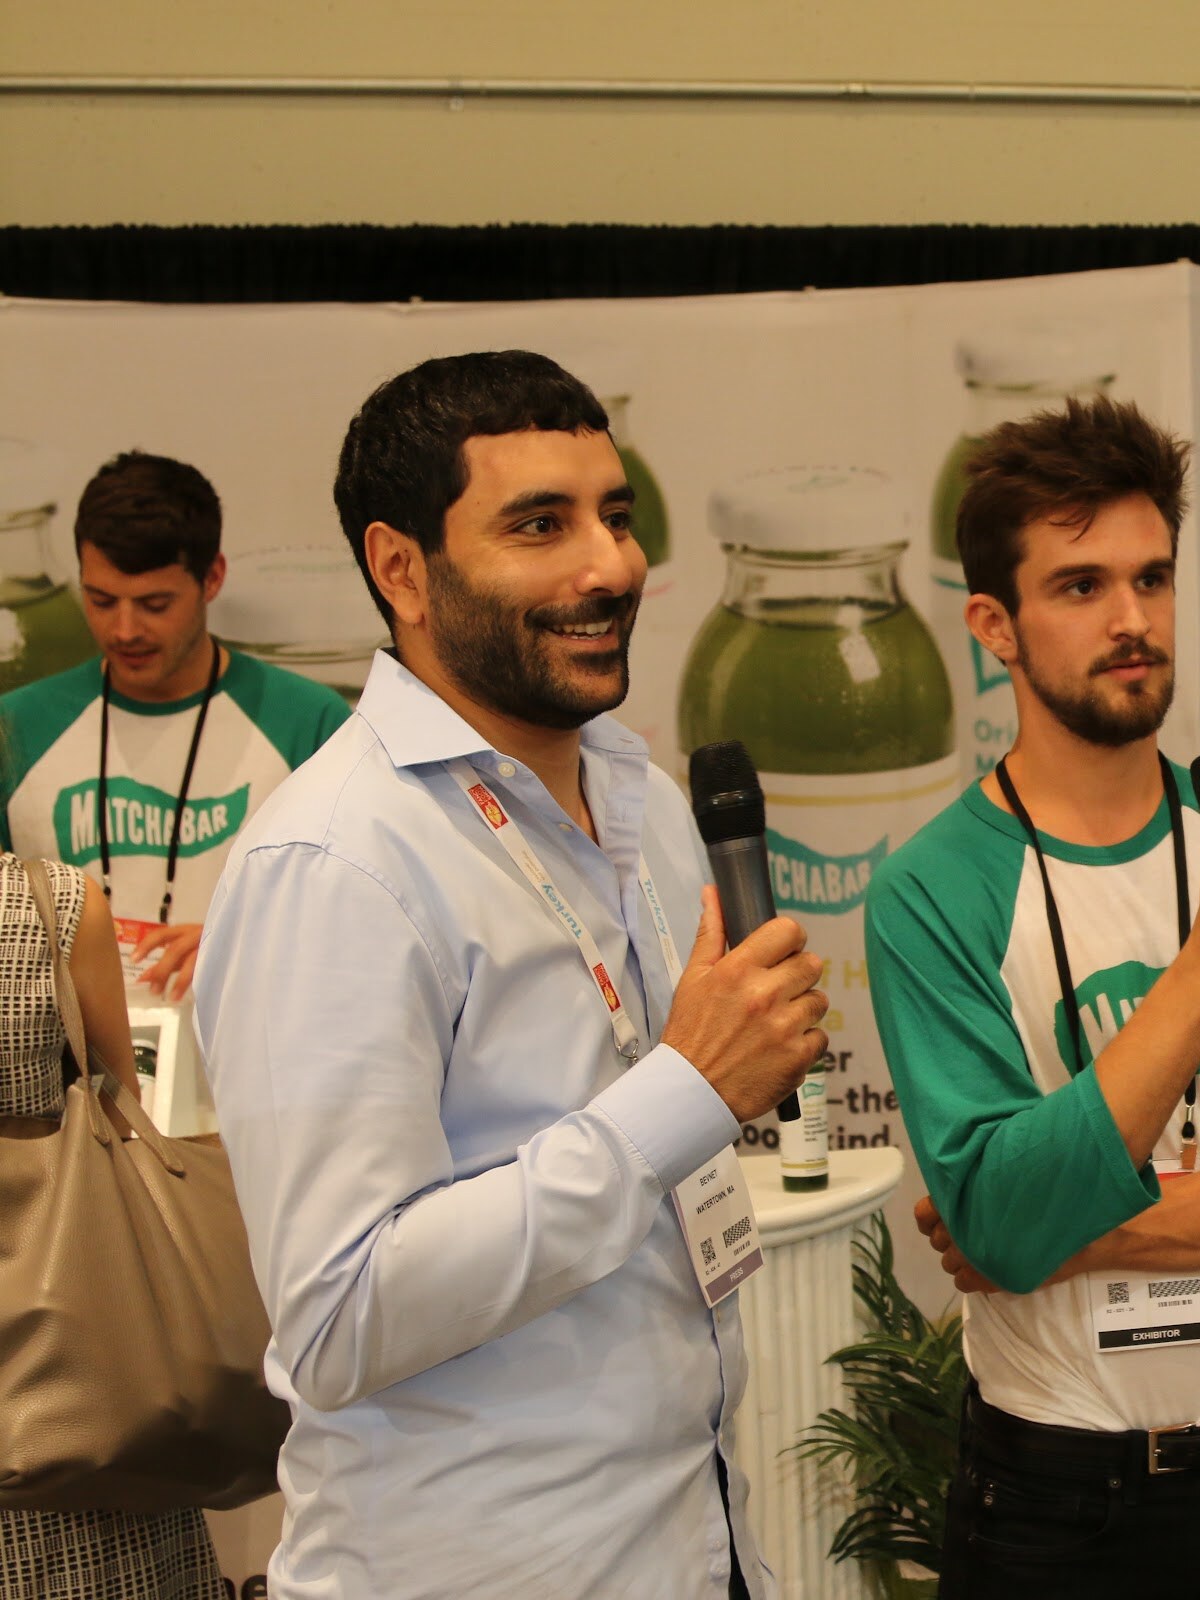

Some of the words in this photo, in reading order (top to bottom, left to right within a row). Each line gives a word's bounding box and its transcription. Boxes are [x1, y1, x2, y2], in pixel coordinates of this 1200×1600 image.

[974, 719, 1014, 744] Ori
[541, 883, 583, 939] Turkey
[644, 878, 668, 936] Turkey
[843, 960, 870, 989] H
[699, 1169, 718, 1187] BEVNET
[726, 1185, 735, 1194] MA
[729, 1267, 744, 1282] PRESS
[1132, 1329, 1181, 1341] EXHIBITOR
